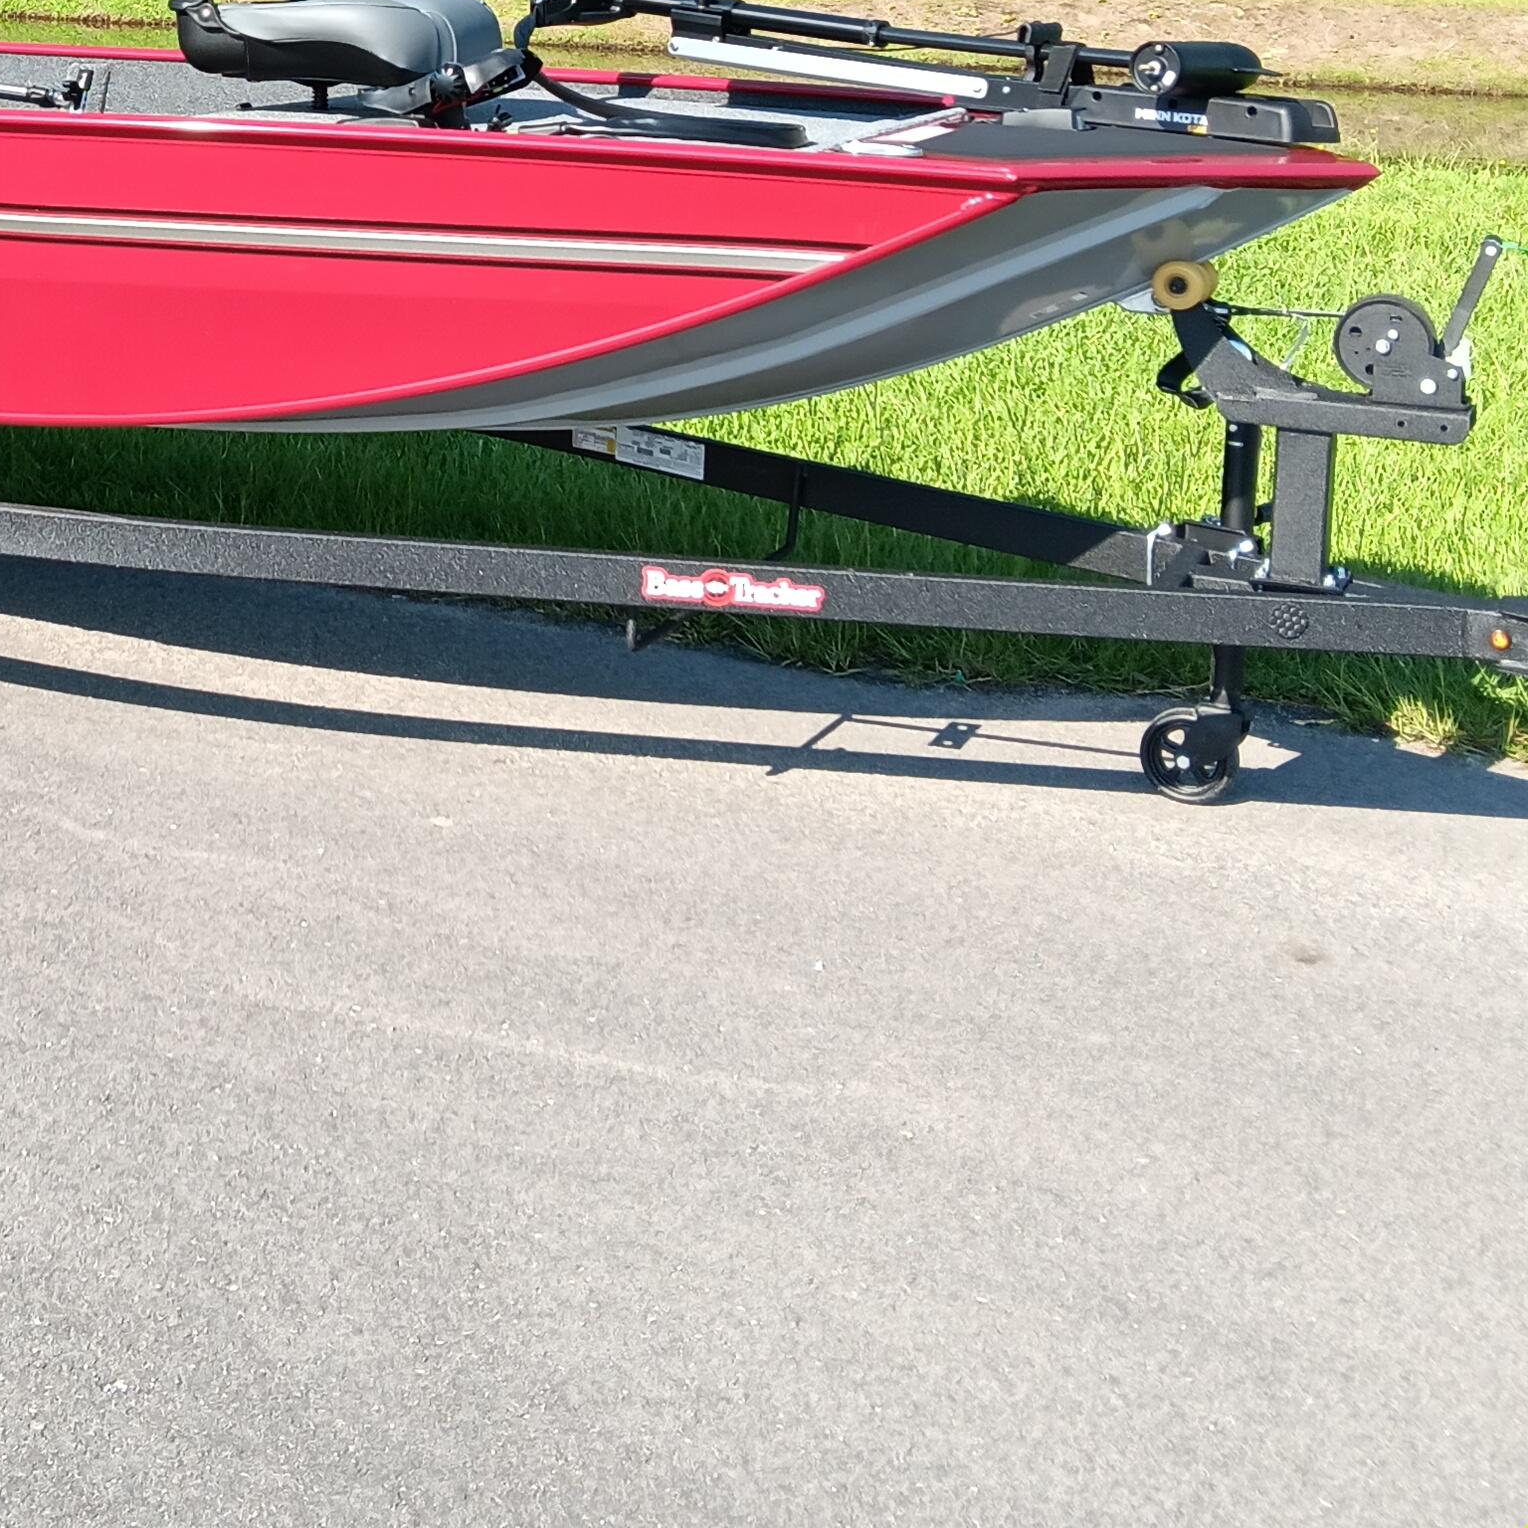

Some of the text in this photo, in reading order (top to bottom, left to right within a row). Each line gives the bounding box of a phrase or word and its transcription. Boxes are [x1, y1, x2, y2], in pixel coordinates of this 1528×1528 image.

[1134, 107, 1209, 126] MINN KOTA
[645, 570, 821, 608] Bass Tracker
